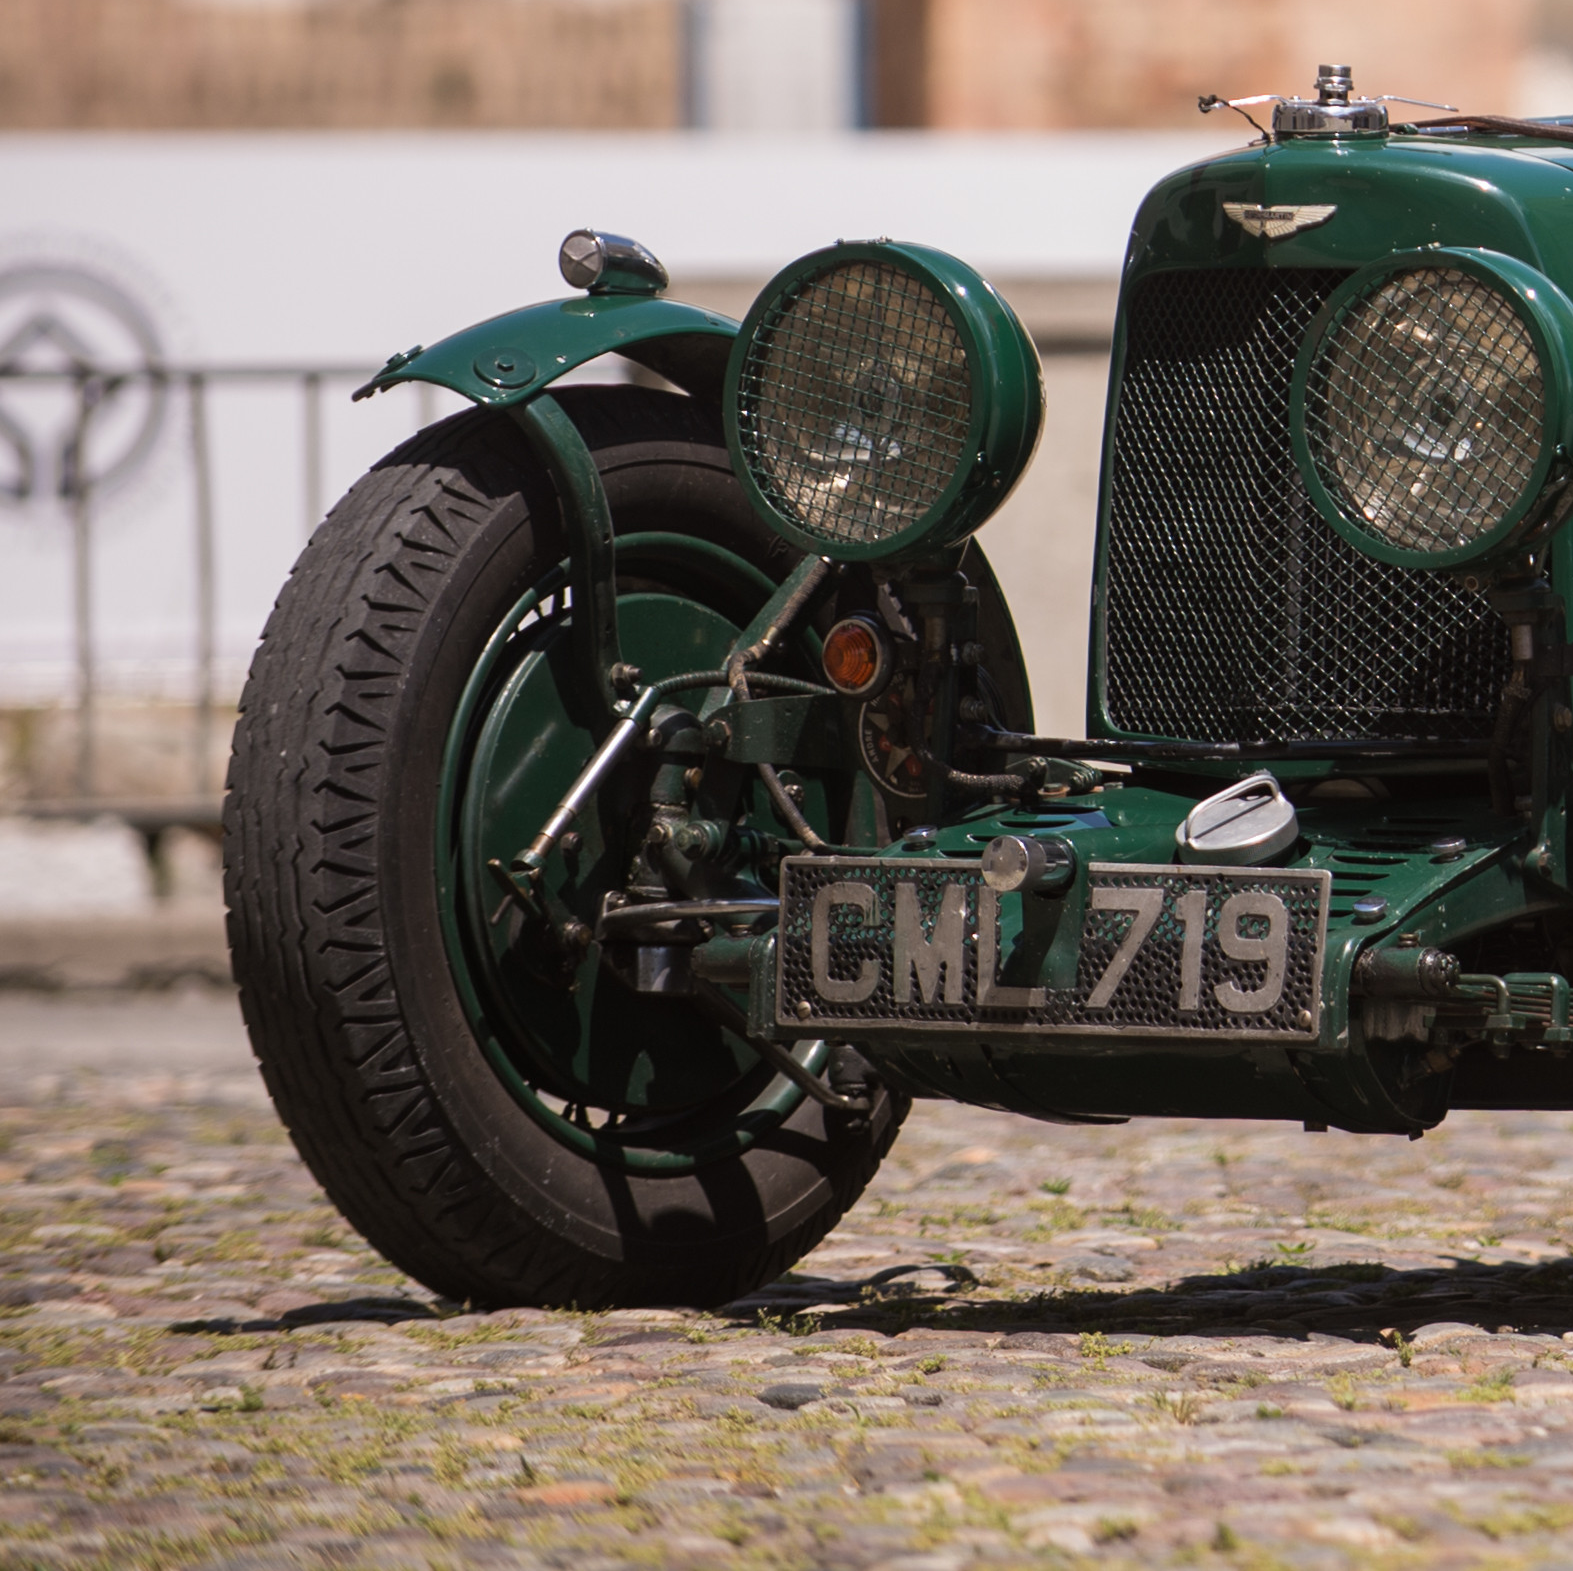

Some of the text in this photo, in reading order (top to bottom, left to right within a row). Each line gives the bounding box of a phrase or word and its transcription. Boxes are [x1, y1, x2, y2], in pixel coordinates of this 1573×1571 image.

[864, 729, 879, 763] ANDRE
[811, 881, 1290, 1014] CML 719
